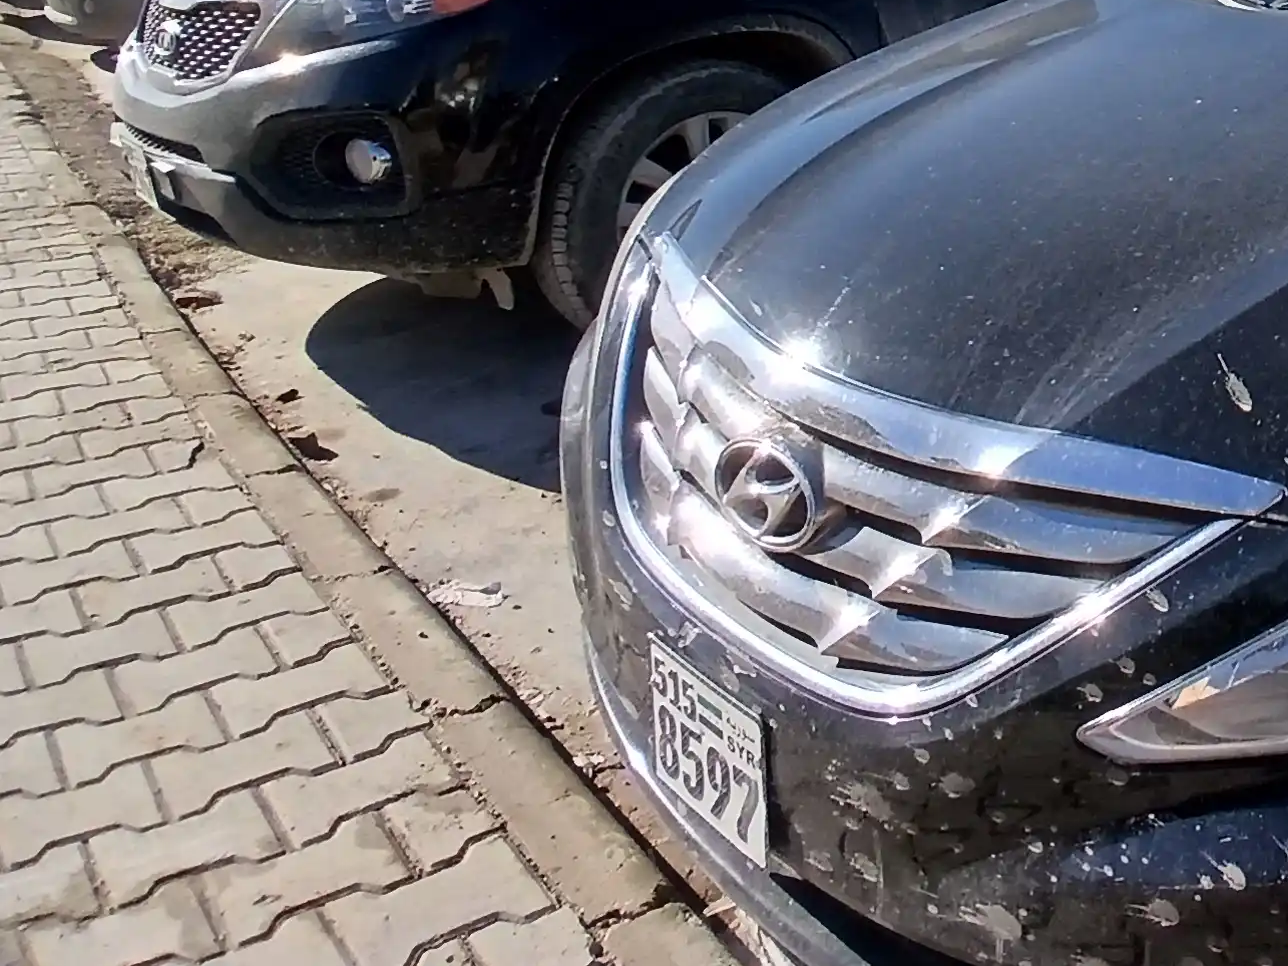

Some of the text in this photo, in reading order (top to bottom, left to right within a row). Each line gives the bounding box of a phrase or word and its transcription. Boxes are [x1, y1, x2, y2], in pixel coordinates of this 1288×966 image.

[653, 655, 697, 723] 515
[658, 704, 760, 844] 8597
[727, 735, 757, 770] SYR
